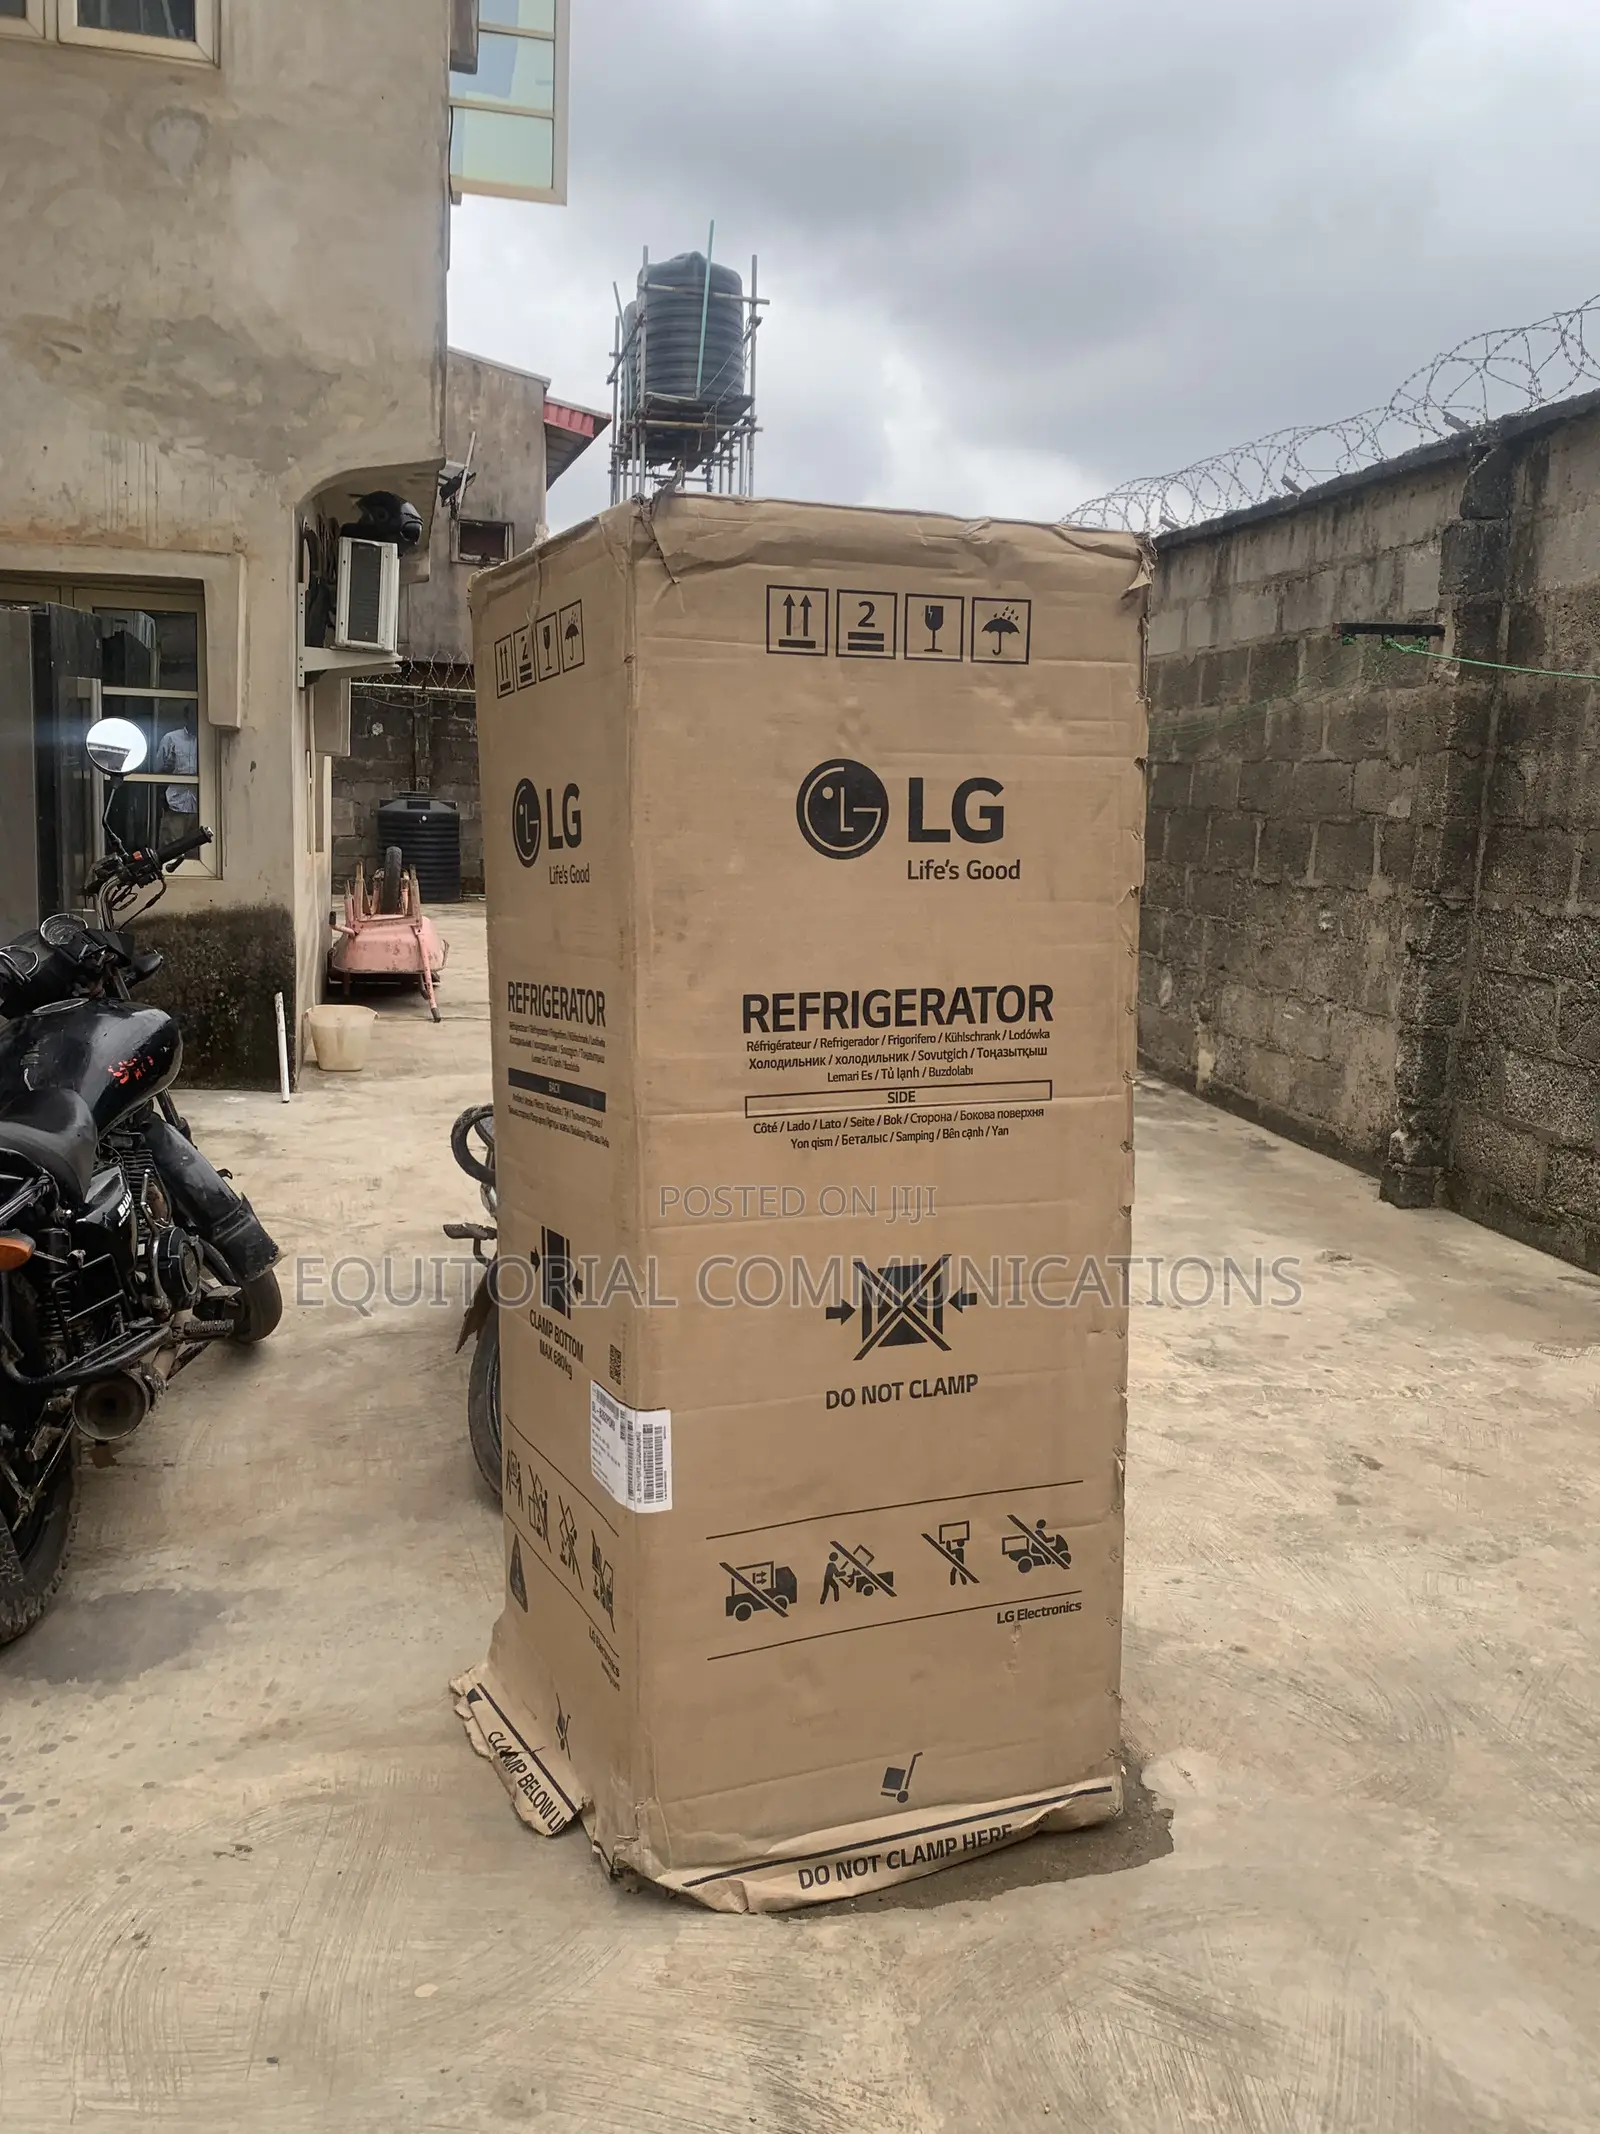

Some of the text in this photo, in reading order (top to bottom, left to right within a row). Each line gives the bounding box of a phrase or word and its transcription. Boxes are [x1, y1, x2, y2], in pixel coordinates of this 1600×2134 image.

[857, 600, 876, 627] 2
[546, 782, 582, 850] LG
[908, 777, 1004, 844] LG
[570, 862, 590, 884] Good
[907, 859, 1021, 880] Life's Good
[507, 981, 607, 1028] REFRIGERATOR
[742, 984, 1055, 1033] REFRIGERATOR
[746, 1040, 812, 1053] Réfrigérateur
[820, 1036, 879, 1050] Refrigerador
[888, 1033, 937, 1048] Frigorifero
[945, 1030, 1001, 1043] Kühlschrank
[1009, 1028, 1051, 1041] Lodówka
[749, 1056, 826, 1071] Холодильник
[835, 1053, 909, 1066] холодильник
[918, 1048, 968, 1062] Sovutgich
[827, 1071, 859, 1082] Lemari
[861, 1070, 873, 1081] Es
[887, 1090, 916, 1104] SIDE
[753, 1122, 778, 1134] Côté
[787, 1120, 811, 1132] Lado
[820, 1118, 841, 1130] Lato
[850, 1116, 875, 1128] Seite
[883, 1114, 902, 1125] Bok
[910, 1112, 952, 1125] Сторона
[960, 1109, 995, 1121] Бокова
[997, 1108, 1044, 1120] поверхня
[790, 1138, 809, 1149] Yon
[811, 1137, 833, 1150] qism
[896, 1130, 935, 1143] Samping
[942, 1127, 960, 1139] Bên
[962, 1127, 984, 1140] cạnh
[991, 1125, 1009, 1136] Yan
[530, 1309, 584, 1363] CLAMP BOTTOM
[539, 1339, 553, 1362] MAX
[826, 1373, 979, 1410] DO NOT CLAMP
[996, 1601, 1082, 1624] LG Electronics
[517, 1772, 556, 1820] BELOW
[798, 1864, 830, 1890] DO
[836, 1854, 881, 1881] NOT
[886, 1837, 957, 1870] CLAMP
